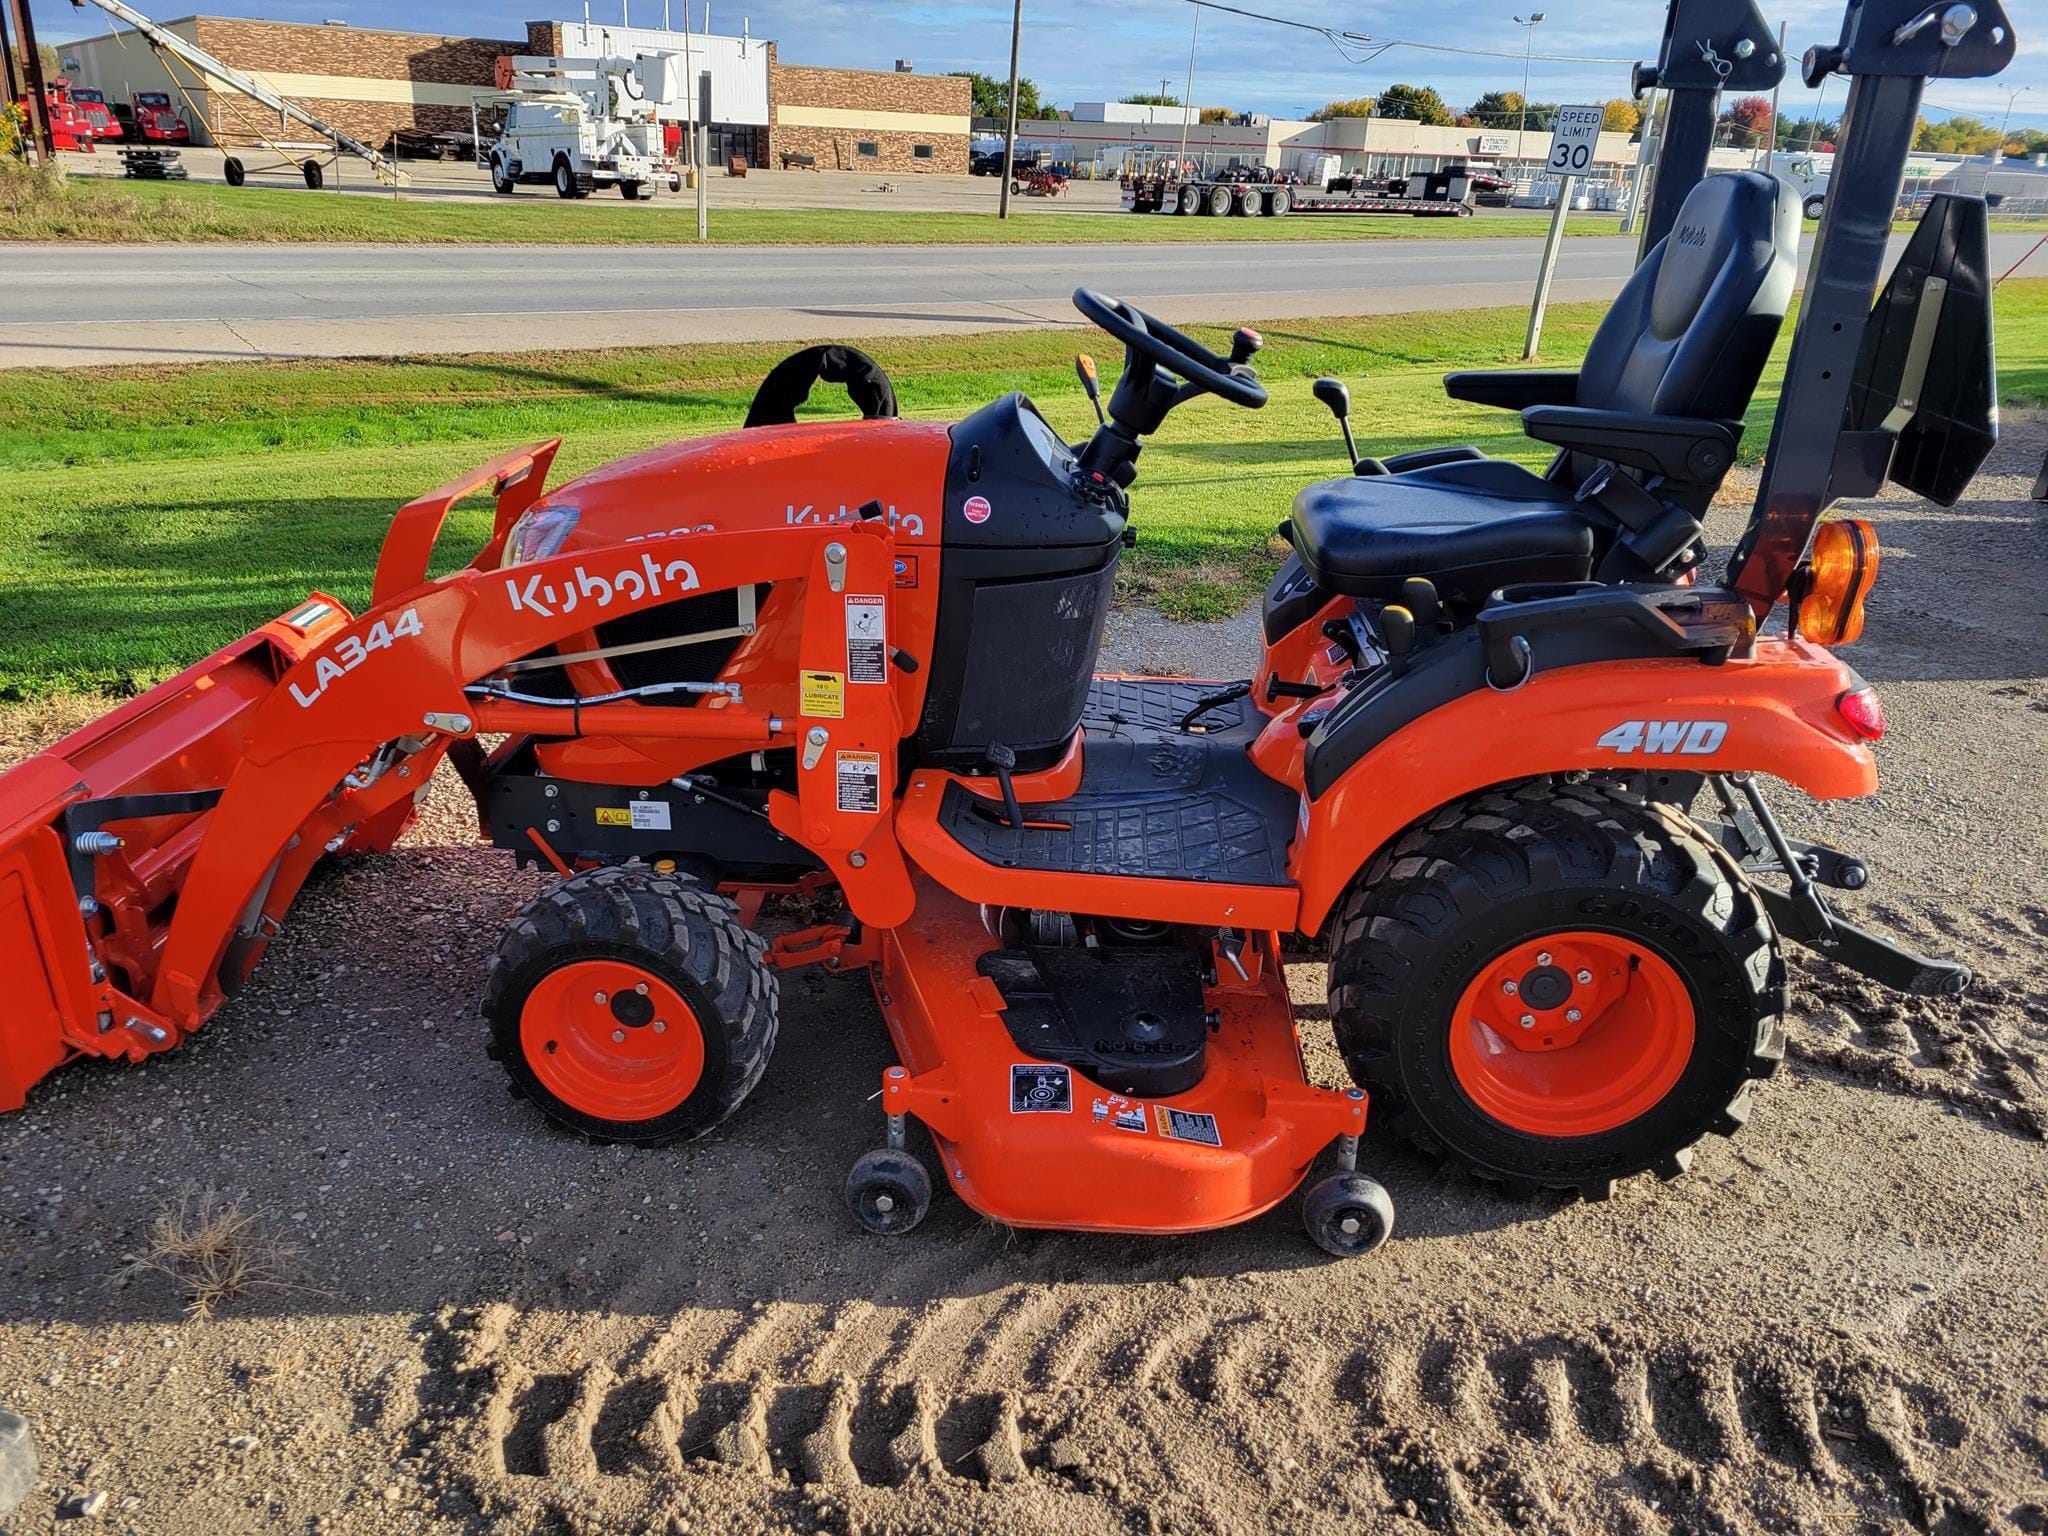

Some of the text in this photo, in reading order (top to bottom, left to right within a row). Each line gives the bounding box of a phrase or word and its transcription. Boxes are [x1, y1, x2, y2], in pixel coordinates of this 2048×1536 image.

[1561, 111, 1599, 125] SPEED
[1562, 126, 1593, 138] LIMIT
[1552, 143, 1590, 169] 30
[505, 553, 701, 618] Kubota
[853, 597, 883, 605] DANGER
[287, 607, 424, 710] LA344
[804, 692, 840, 701] LUBRICATE
[1595, 719, 1730, 755] 4WD
